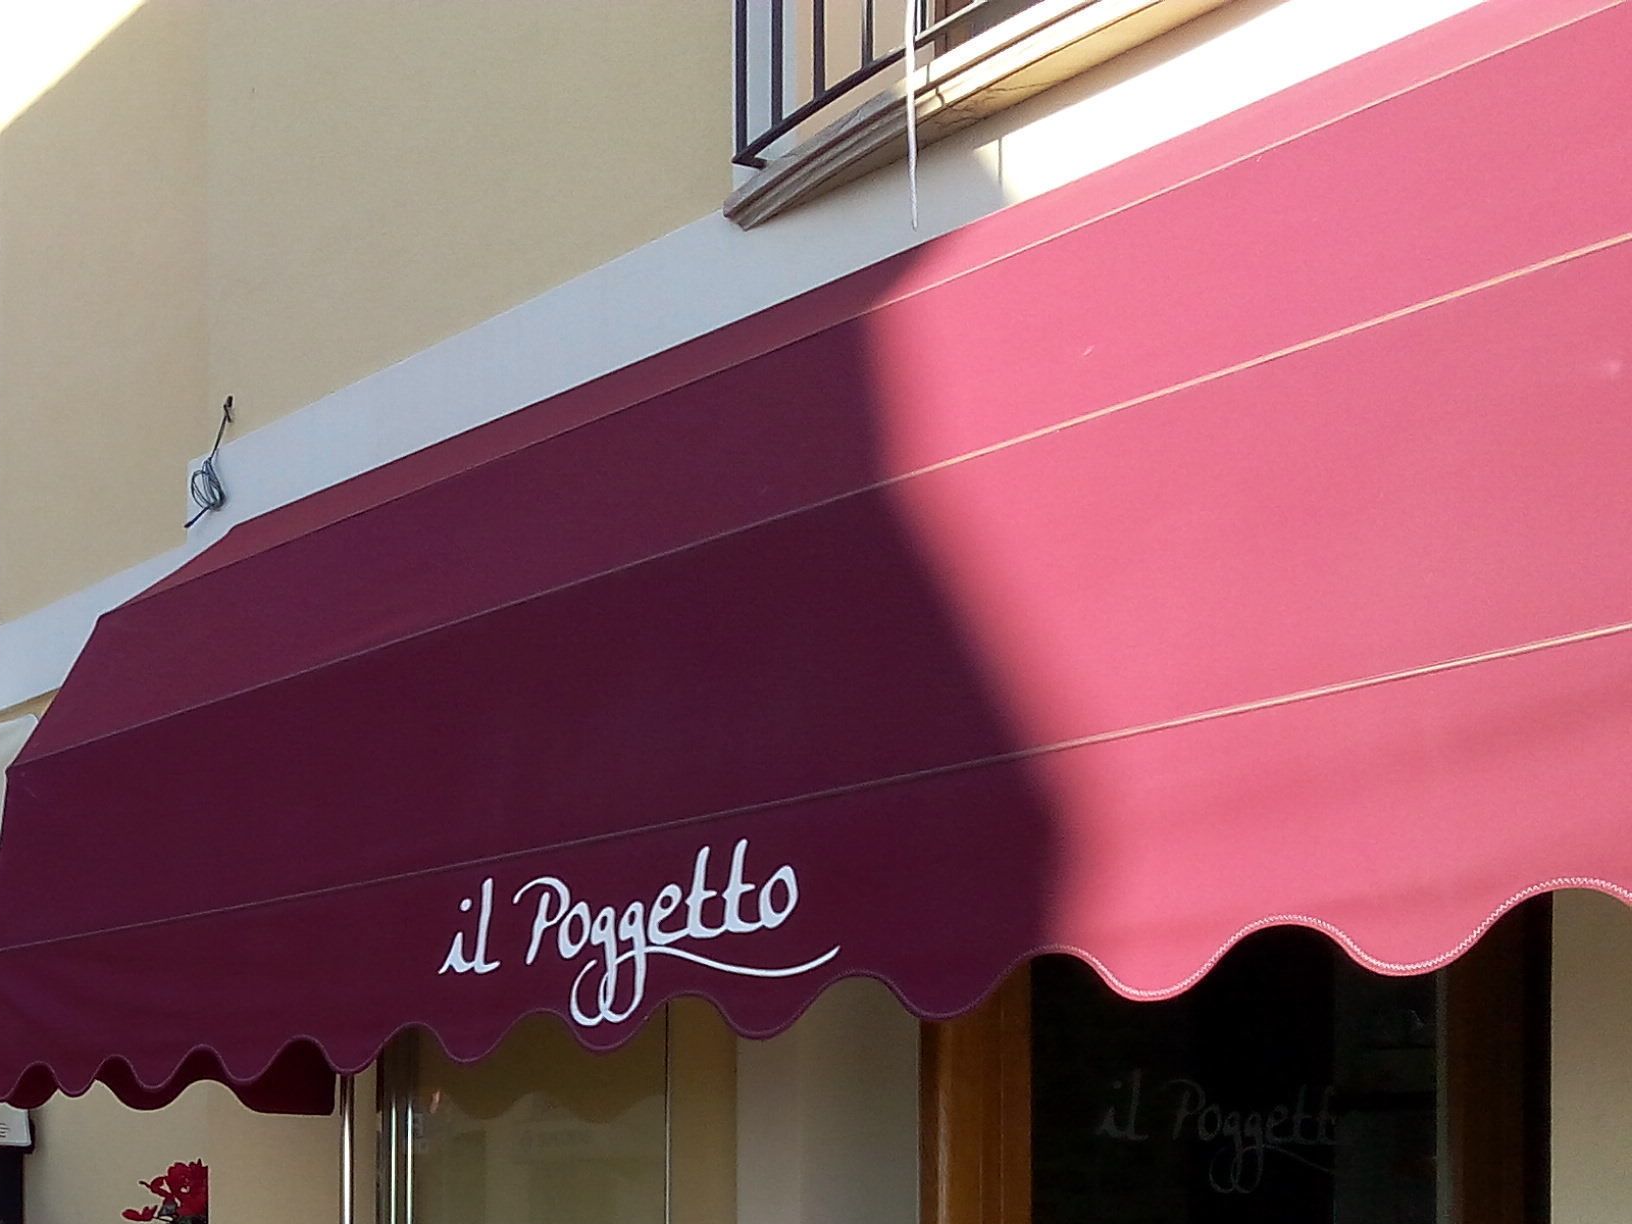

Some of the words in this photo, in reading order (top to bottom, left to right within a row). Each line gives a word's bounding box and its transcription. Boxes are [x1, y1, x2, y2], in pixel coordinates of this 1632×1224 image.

[438, 877, 500, 974] il
[513, 838, 840, 1026] Poggetto
[1093, 1067, 1150, 1141] il
[1166, 1078, 1340, 1194] Poggett
